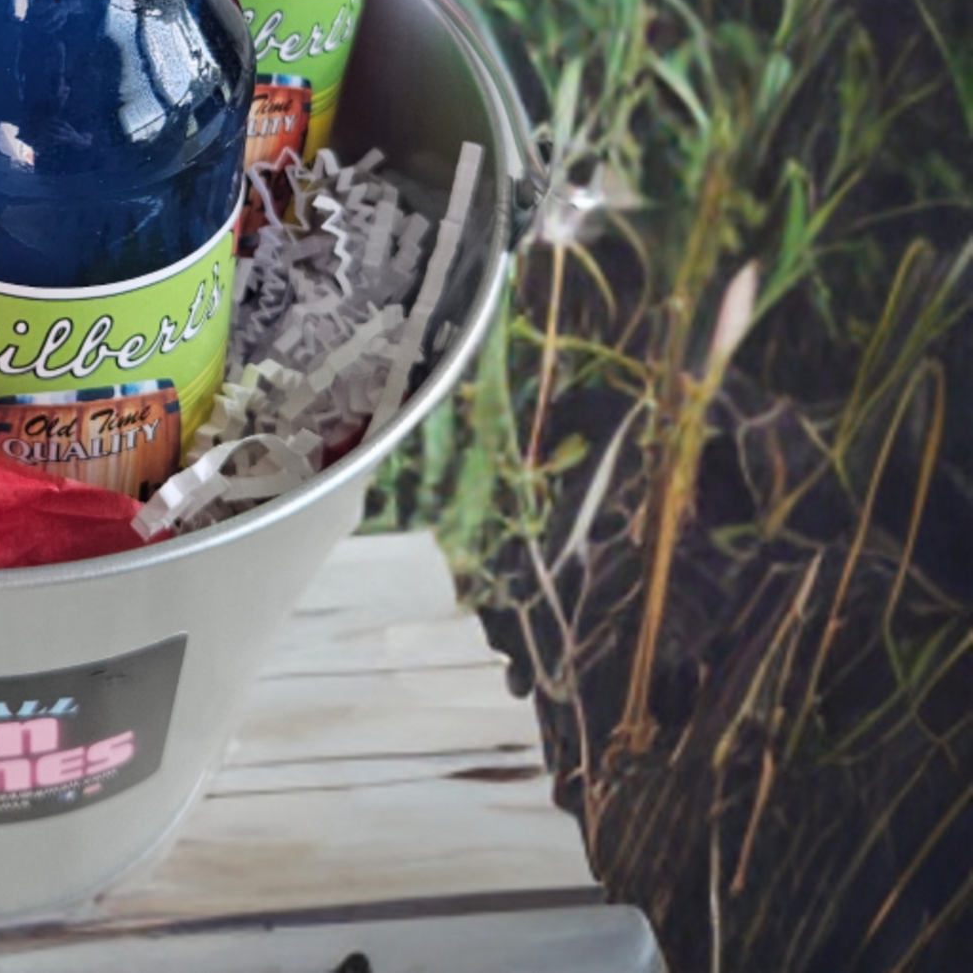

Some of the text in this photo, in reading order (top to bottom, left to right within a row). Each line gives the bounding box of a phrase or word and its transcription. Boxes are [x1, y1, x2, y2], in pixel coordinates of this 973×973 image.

[1, 417, 162, 467] QUALITY
[23, 402, 152, 439] Old Time
